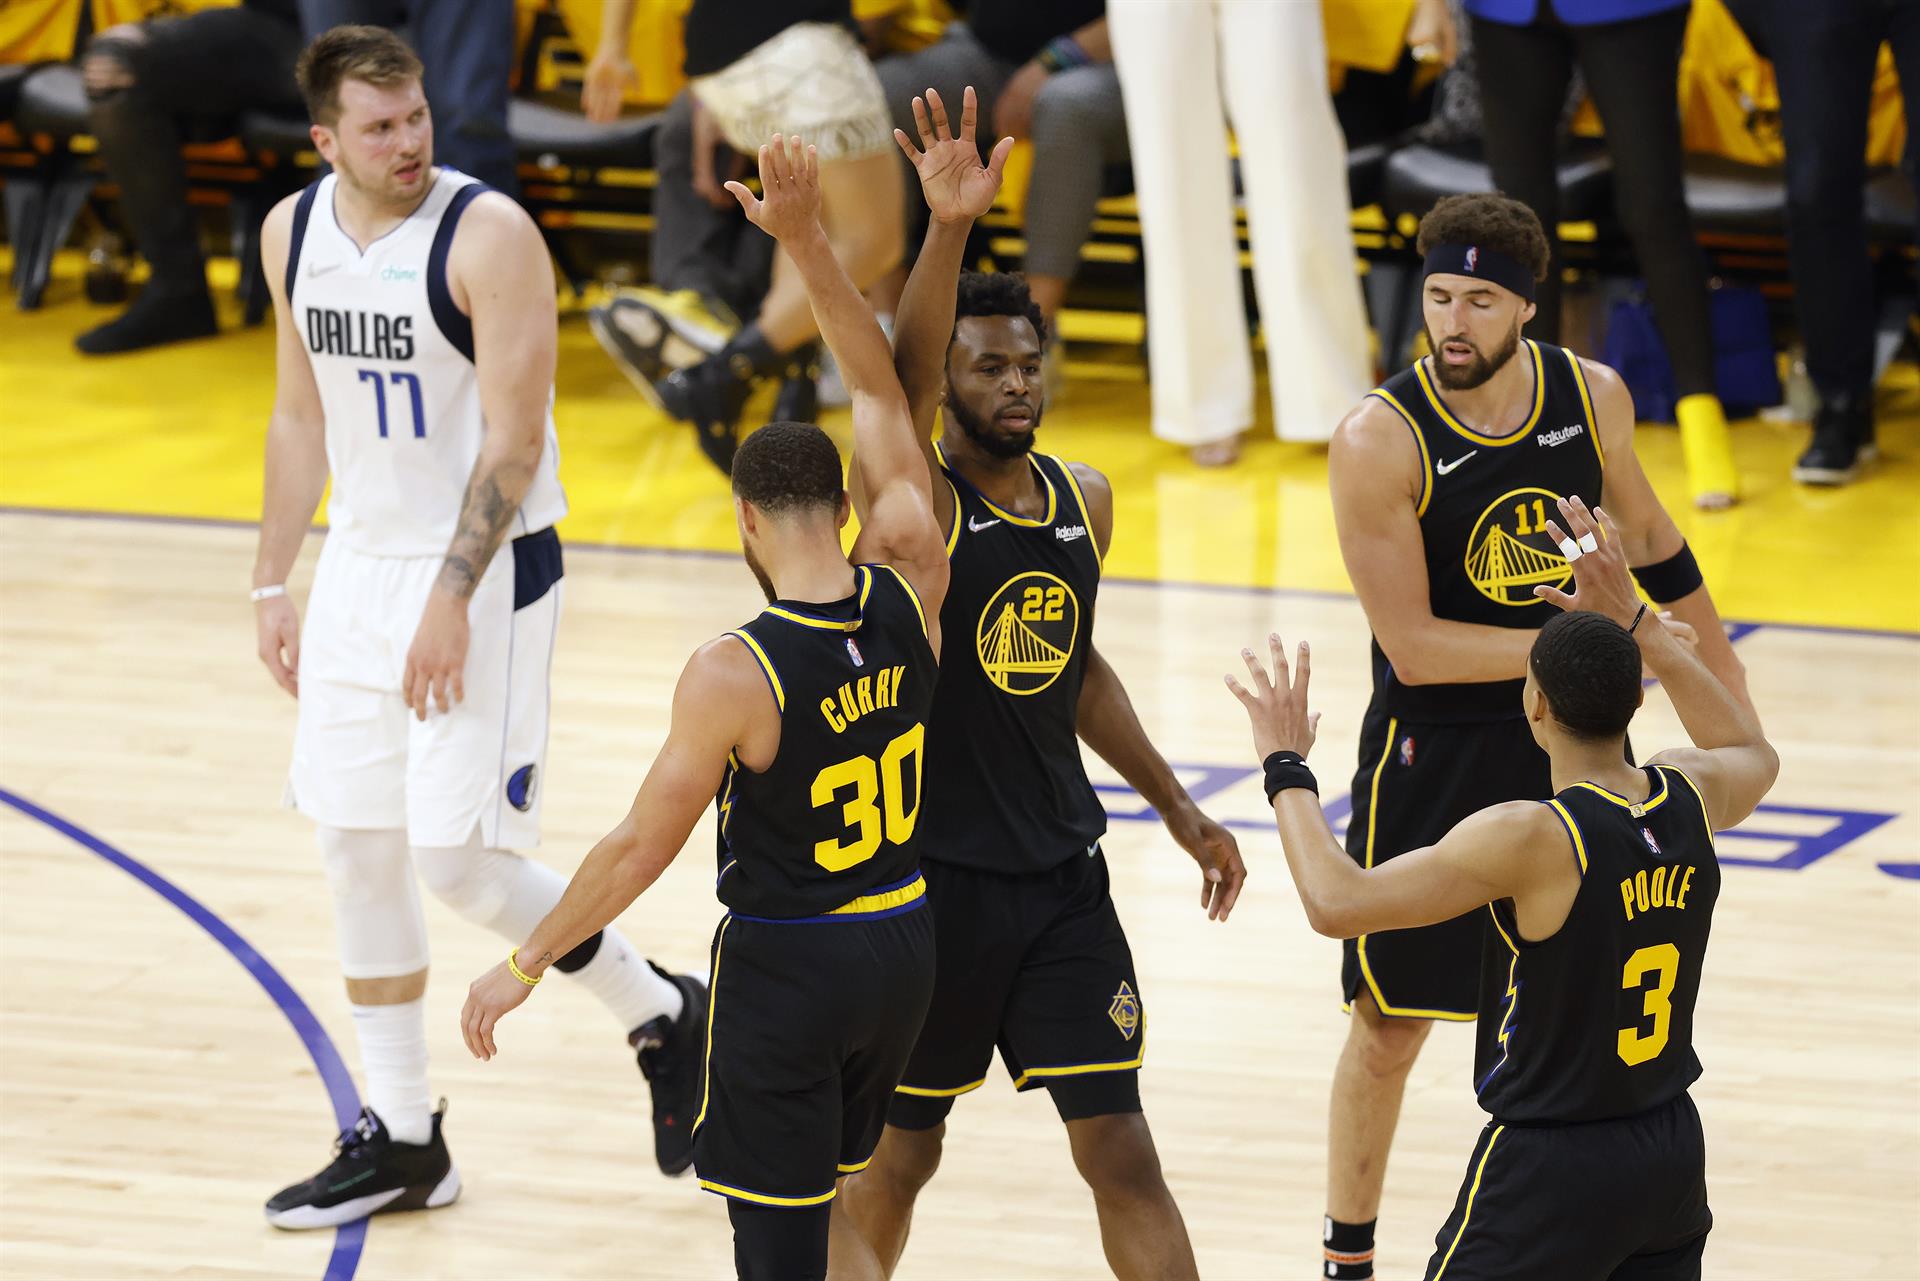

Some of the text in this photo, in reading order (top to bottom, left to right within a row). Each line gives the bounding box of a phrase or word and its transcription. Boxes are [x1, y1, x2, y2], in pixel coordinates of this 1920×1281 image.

[381, 267, 417, 282] chime
[306, 307, 415, 361] DALLAS
[358, 369, 426, 438] 77
[1536, 423, 1583, 447] Rakuten
[1055, 524, 1086, 541] Rakuten
[1514, 499, 1547, 536] 11
[1021, 586, 1066, 621] 22
[820, 665, 906, 734] CURRY
[810, 722, 925, 873] 30
[1620, 864, 1695, 921] POOLE
[1617, 942, 1680, 1067] 3
